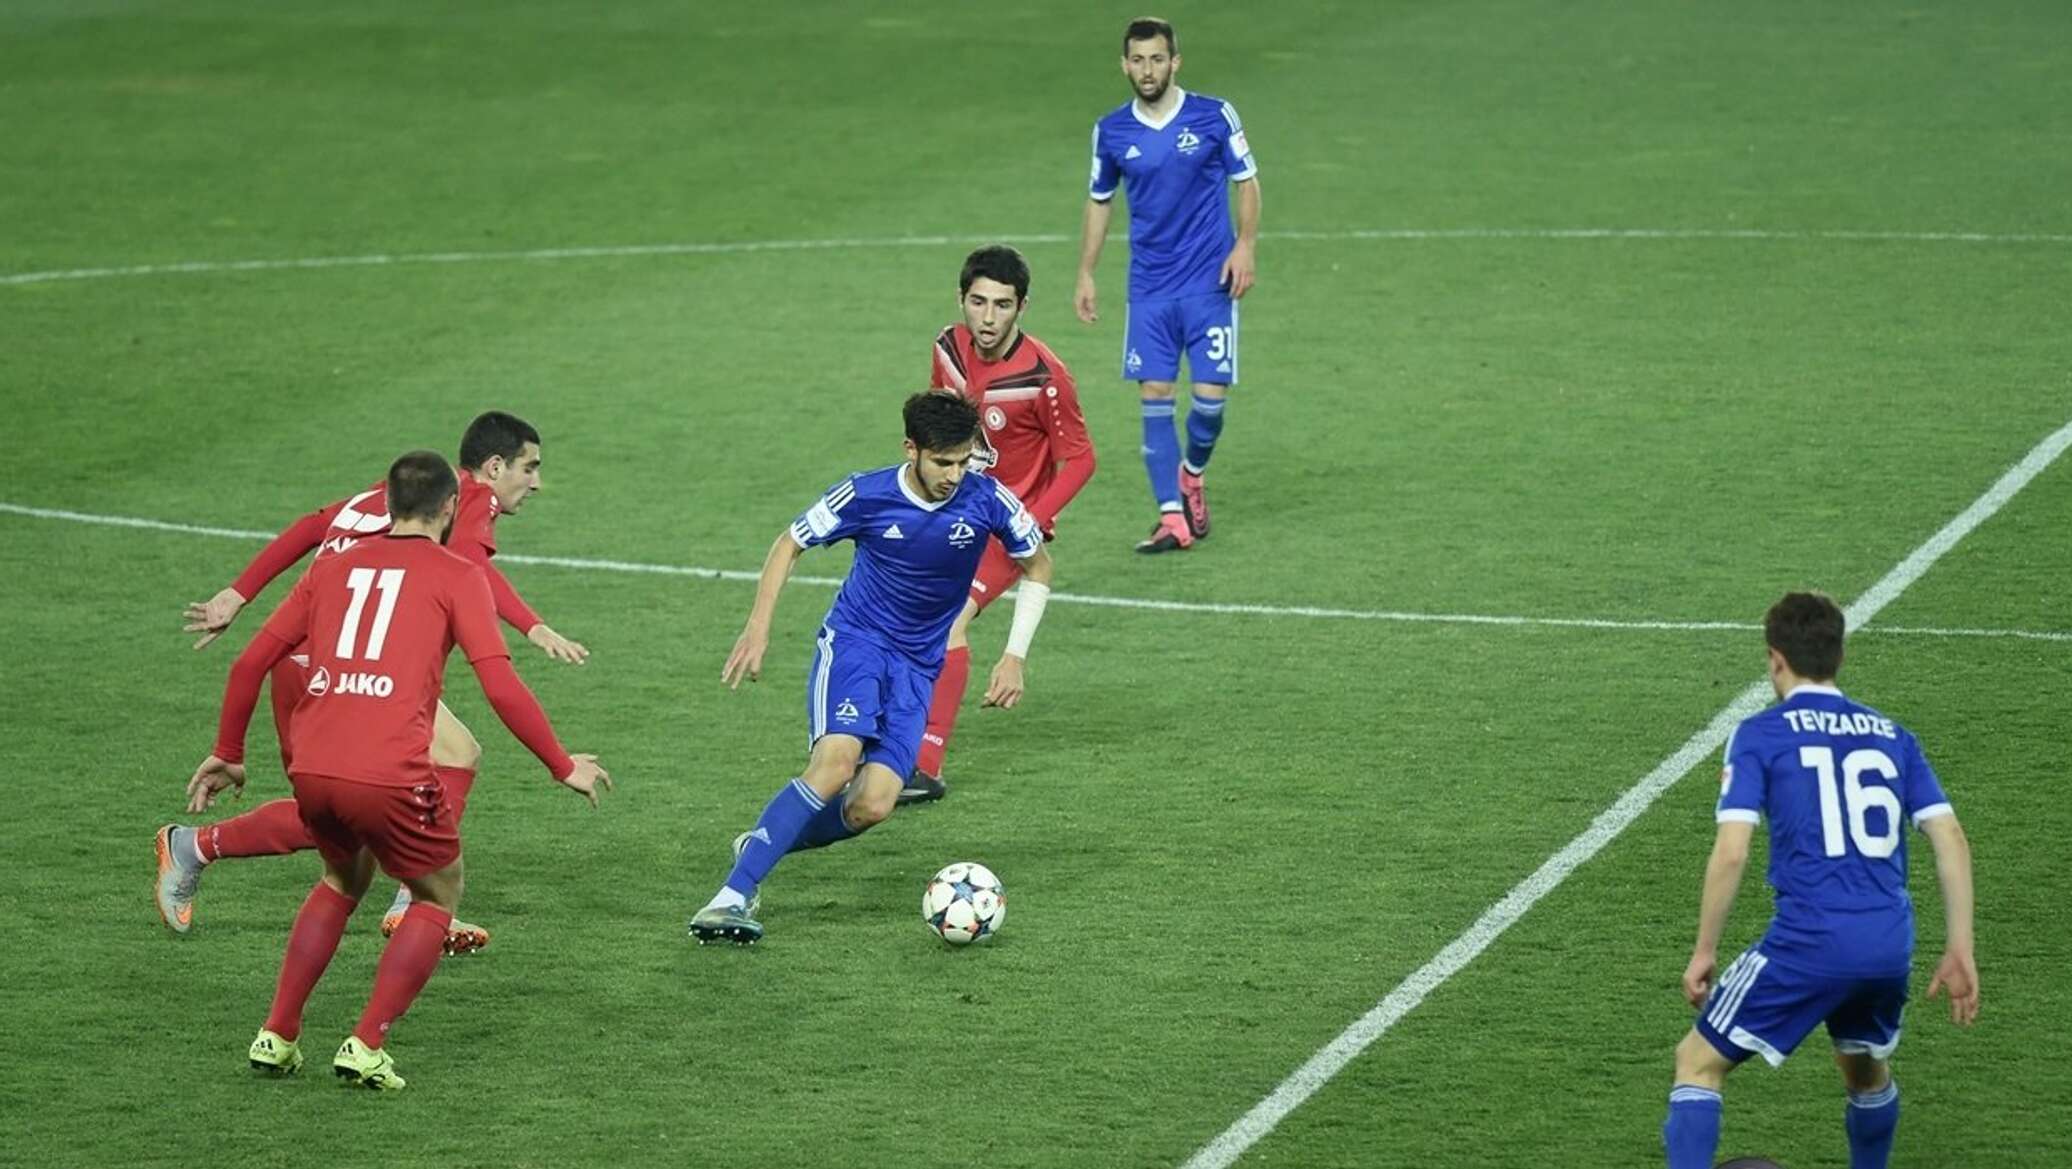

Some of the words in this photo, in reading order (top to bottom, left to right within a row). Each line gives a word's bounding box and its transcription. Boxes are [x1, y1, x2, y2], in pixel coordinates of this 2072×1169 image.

[1206, 326, 1233, 360] 31
[335, 567, 406, 660] 11
[333, 672, 394, 698] JAKO
[1782, 709, 1897, 739] TEVZADZE
[1799, 745, 1902, 859] 16
